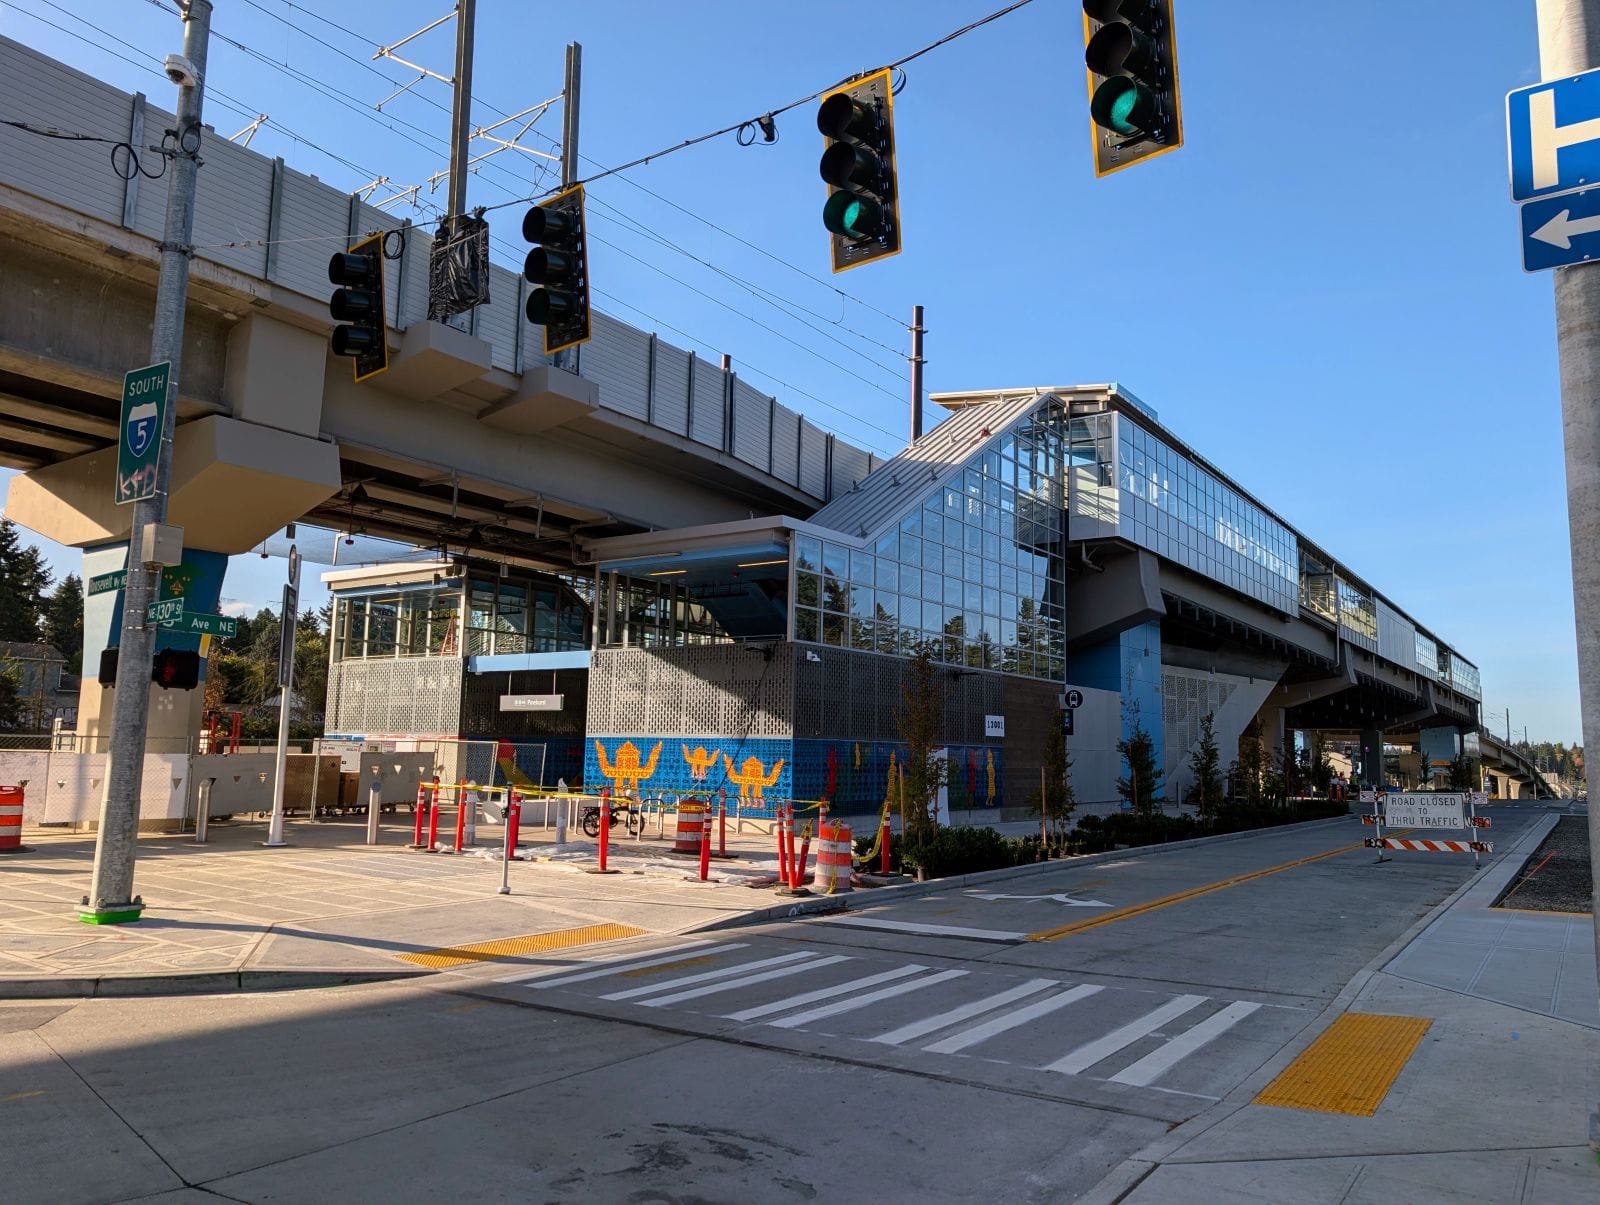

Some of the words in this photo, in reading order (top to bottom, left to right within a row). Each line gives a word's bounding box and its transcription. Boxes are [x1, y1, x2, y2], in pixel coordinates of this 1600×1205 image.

[128, 375, 164, 396] SOUTH
[135, 421, 148, 450] 5
[147, 607, 156, 620] NE
[191, 617, 210, 630] Ave
[219, 621, 234, 633] NE
[1391, 797, 1416, 806] ROAD
[1420, 797, 1456, 806] CLOSED
[1391, 817, 1415, 825] THRU
[1421, 817, 1458, 826] TRAFFIC
